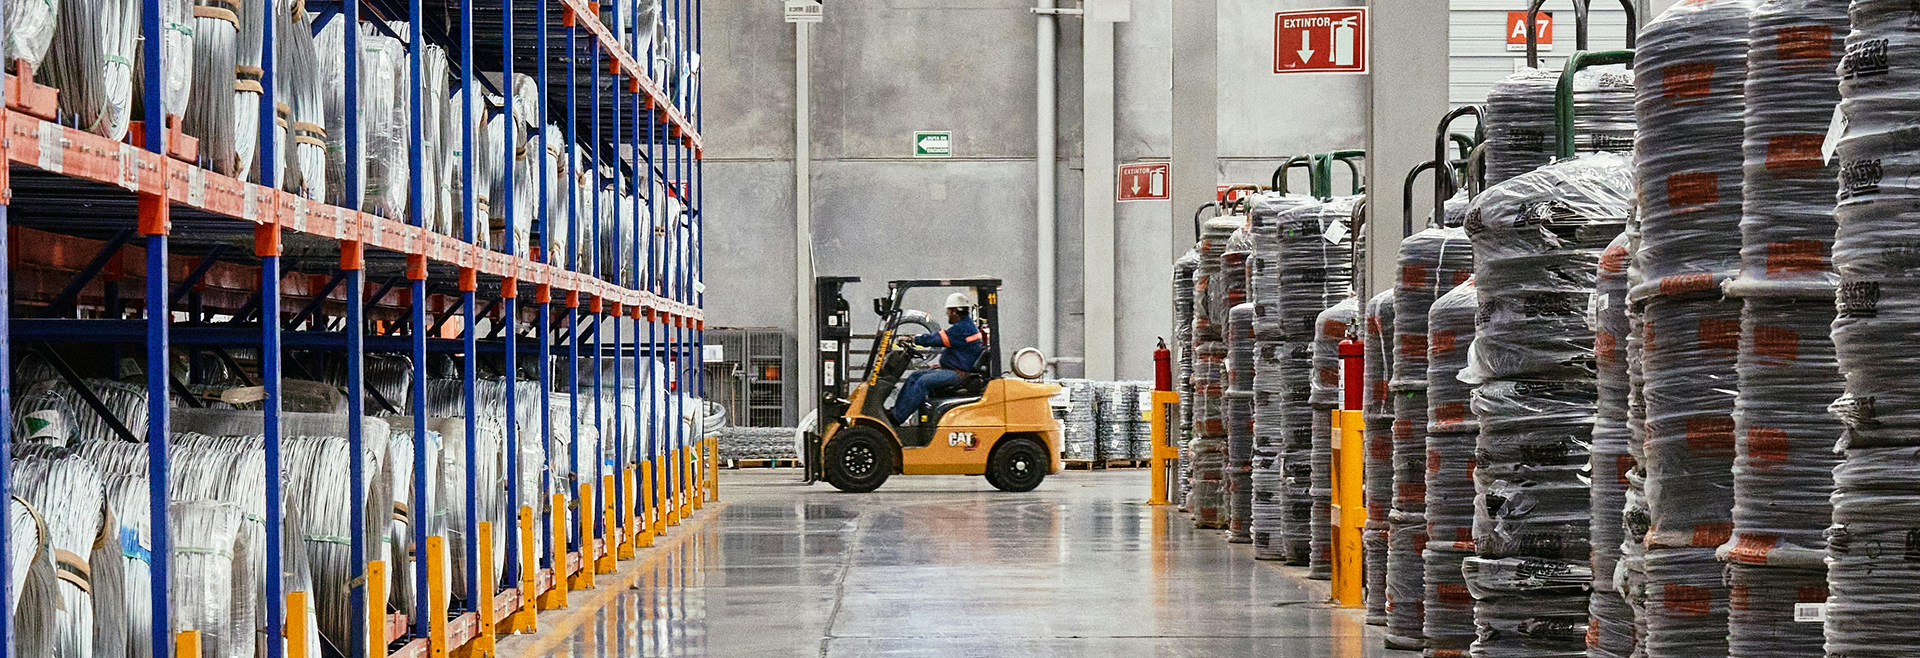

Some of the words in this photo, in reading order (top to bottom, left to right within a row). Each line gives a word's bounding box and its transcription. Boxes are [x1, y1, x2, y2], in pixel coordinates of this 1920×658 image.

[1284, 17, 1331, 29] EXTINTOR
[1123, 167, 1151, 175] EXTINTOR
[948, 432, 974, 447] CAT
